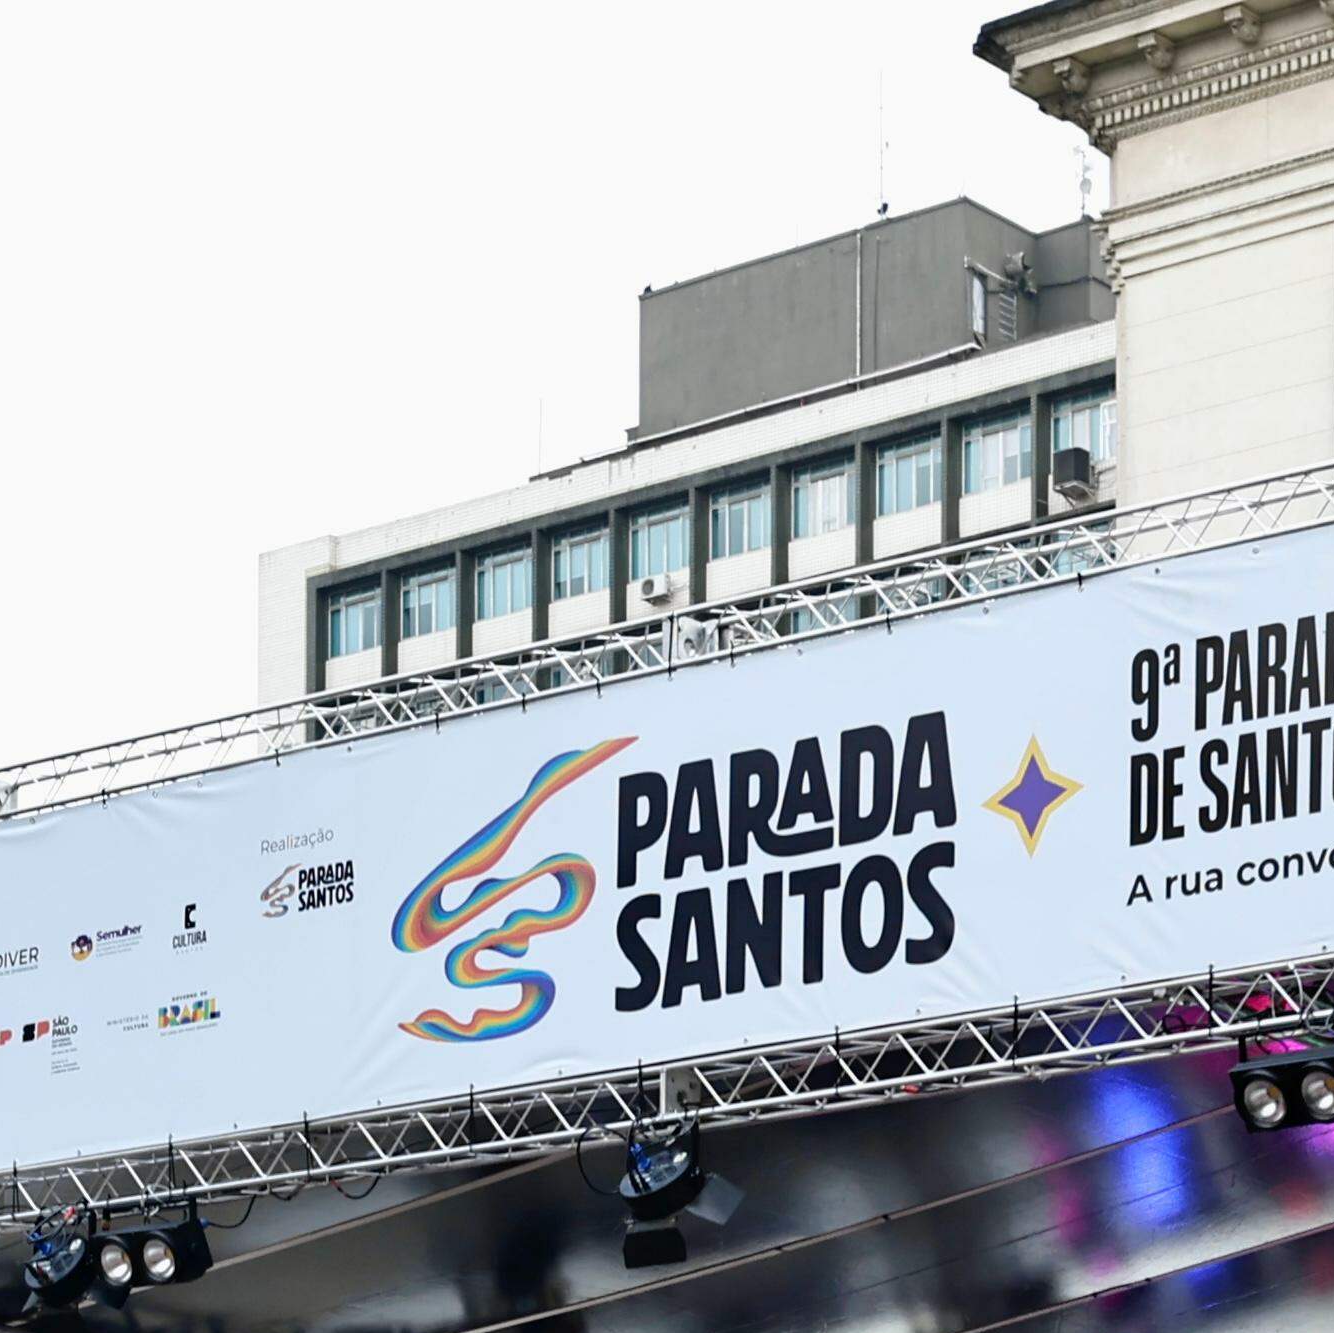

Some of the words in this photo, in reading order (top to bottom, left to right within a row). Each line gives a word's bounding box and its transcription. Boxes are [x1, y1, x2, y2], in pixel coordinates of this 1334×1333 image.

[1130, 643, 1182, 743] 9ª
[616, 710, 957, 889] PARADA
[1129, 745, 1186, 847] DE
[260, 828, 334, 855] Realização
[298, 859, 354, 890] PARADA
[1126, 874, 1153, 907] A
[1165, 868, 1223, 900] rua
[298, 881, 354, 912] SANTOS
[96, 924, 143, 942] Semulher
[172, 930, 207, 949] CULTURA
[614, 840, 957, 1013] SANTOS
[158, 998, 221, 1029] BRASIL
[52, 1024, 79, 1037] PAULO
